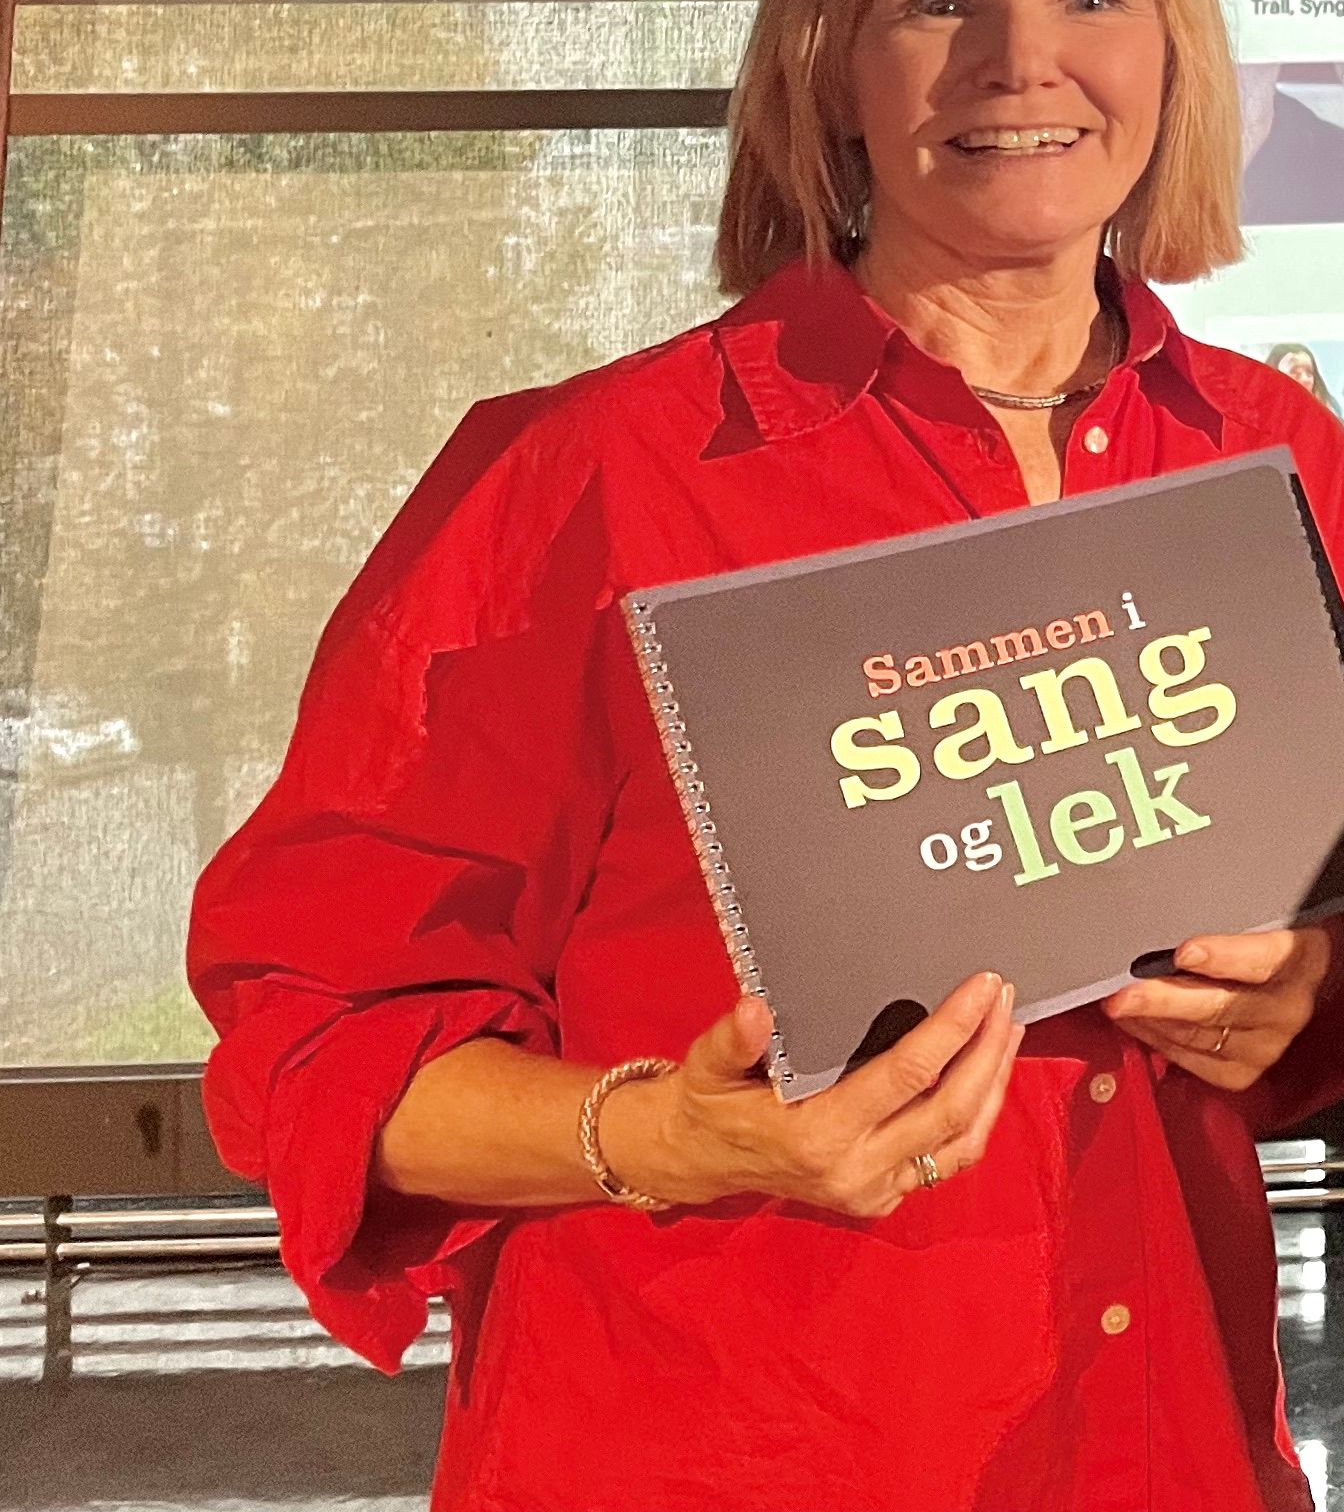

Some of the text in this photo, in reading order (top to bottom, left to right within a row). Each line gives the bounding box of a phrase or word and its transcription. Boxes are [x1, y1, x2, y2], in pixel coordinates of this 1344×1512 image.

[862, 591, 1147, 699] Sammen i
[829, 625, 1238, 810] sang
[919, 746, 1212, 888] og lek
